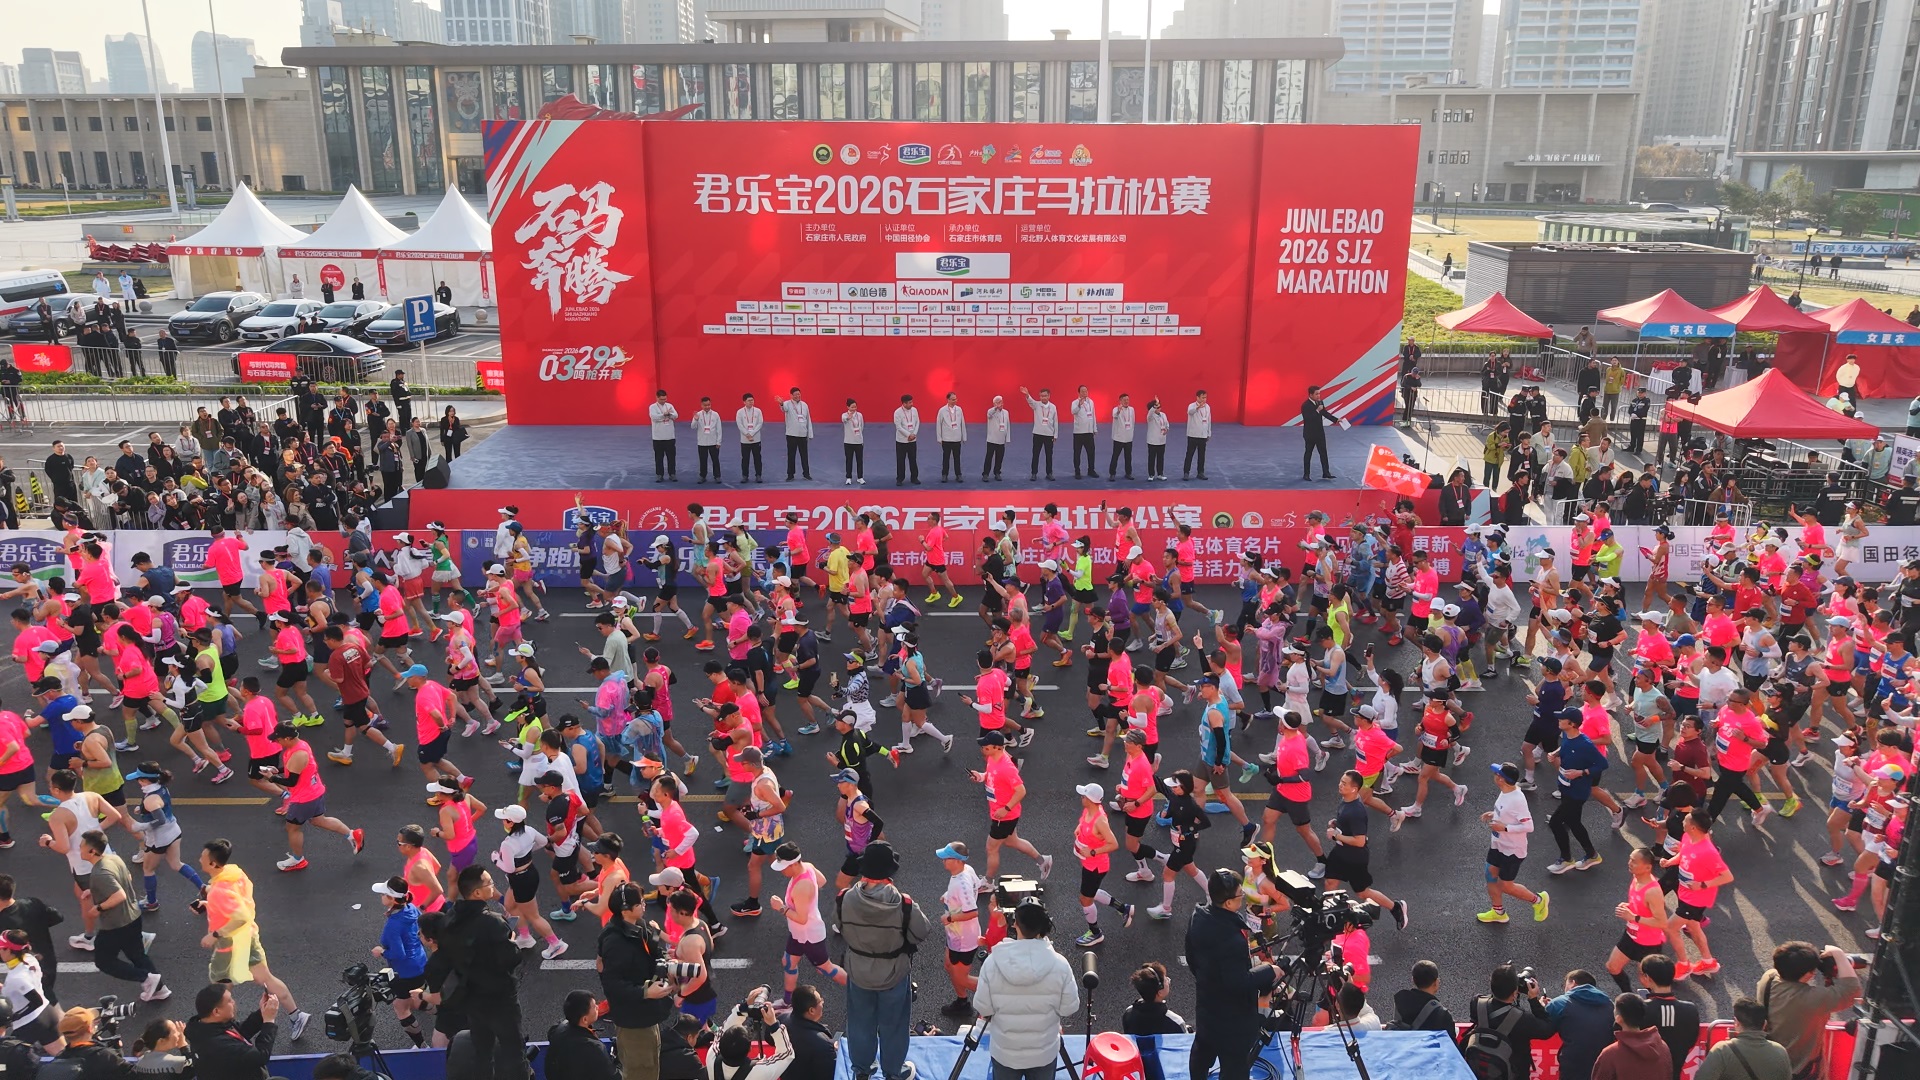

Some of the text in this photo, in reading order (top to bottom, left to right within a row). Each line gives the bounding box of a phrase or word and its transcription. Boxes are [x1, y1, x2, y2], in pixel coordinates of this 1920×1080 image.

[902, 146, 927, 156] 君乐宝
[693, 173, 1212, 216] 君乐宝2026石家庄马拉松赛
[1280, 208, 1385, 235] JUNLEBAO
[805, 223, 836, 232] 主办单位
[884, 223, 916, 233] 认证单位
[948, 223, 980, 233] 承办单位
[1020, 223, 1052, 233] 运营单位
[805, 233, 867, 243] 石家庄市人民政府
[884, 233, 931, 243] 中国田径协会
[948, 234, 1003, 243] 石家庄市体育局
[1020, 234, 1127, 244] 河北野人体育文化发展有限公司
[1278, 238, 1374, 264] 2026 SJZ
[1794, 243, 1891, 254] 地下停车场入口
[940, 257, 967, 268] 君乐宝
[1276, 269, 1389, 294] MARATHON
[859, 287, 888, 298] 丛台酒
[909, 287, 949, 296] QIAODAN
[976, 287, 1003, 295] 河北银行
[1086, 287, 1115, 297] 补水啦
[410, 299, 429, 327] P
[1669, 324, 1708, 336] 存衣区
[1866, 332, 1906, 344] 女更衣
[573, 369, 623, 381] 鸣枪开赛
[664, 508, 680, 529] MARATHON
[1, 543, 57, 563] 君乐宝
[172, 543, 209, 563] 君乐
